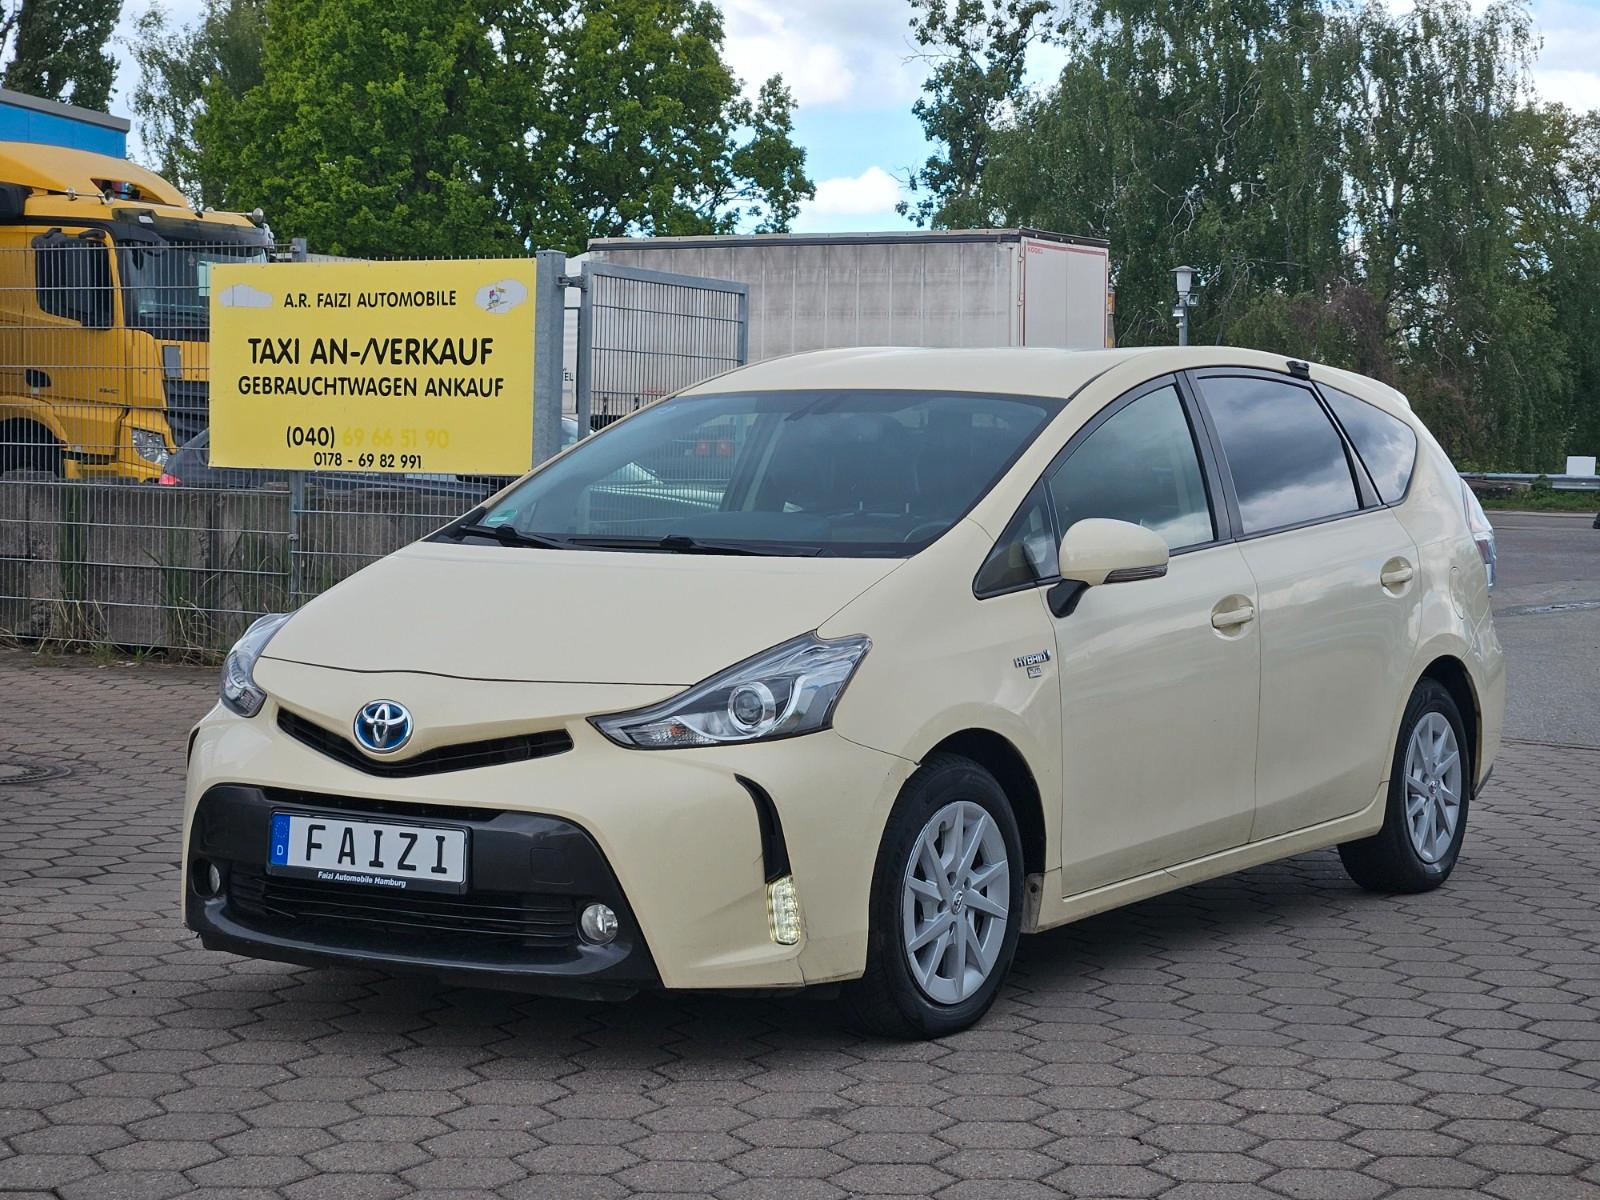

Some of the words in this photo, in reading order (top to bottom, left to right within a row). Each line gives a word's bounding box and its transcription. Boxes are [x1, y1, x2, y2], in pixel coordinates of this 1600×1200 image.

[284, 293, 311, 308] A.R.
[317, 292, 351, 308] FAIZI
[357, 290, 457, 308] AUTOMOBILE
[247, 338, 300, 365] TAXI
[310, 338, 494, 366] AN-/VERKAUF
[238, 375, 417, 397] GEBRAUCHTWAGEN
[425, 377, 504, 397] ANKAUF
[286, 426, 335, 449] (040)
[343, 429, 364, 447] 69
[371, 429, 393, 447] 66
[401, 429, 417, 448] 51
[425, 429, 449, 449] 90
[313, 452, 342, 466] 0178
[358, 453, 375, 468] 69
[379, 454, 395, 468] 82
[400, 454, 422, 469] 991
[276, 845, 284, 856] D
[305, 824, 448, 874] FAIZI
[317, 871, 334, 881] Faizi
[335, 872, 373, 884] Automobile
[374, 876, 407, 888] Hamburg
